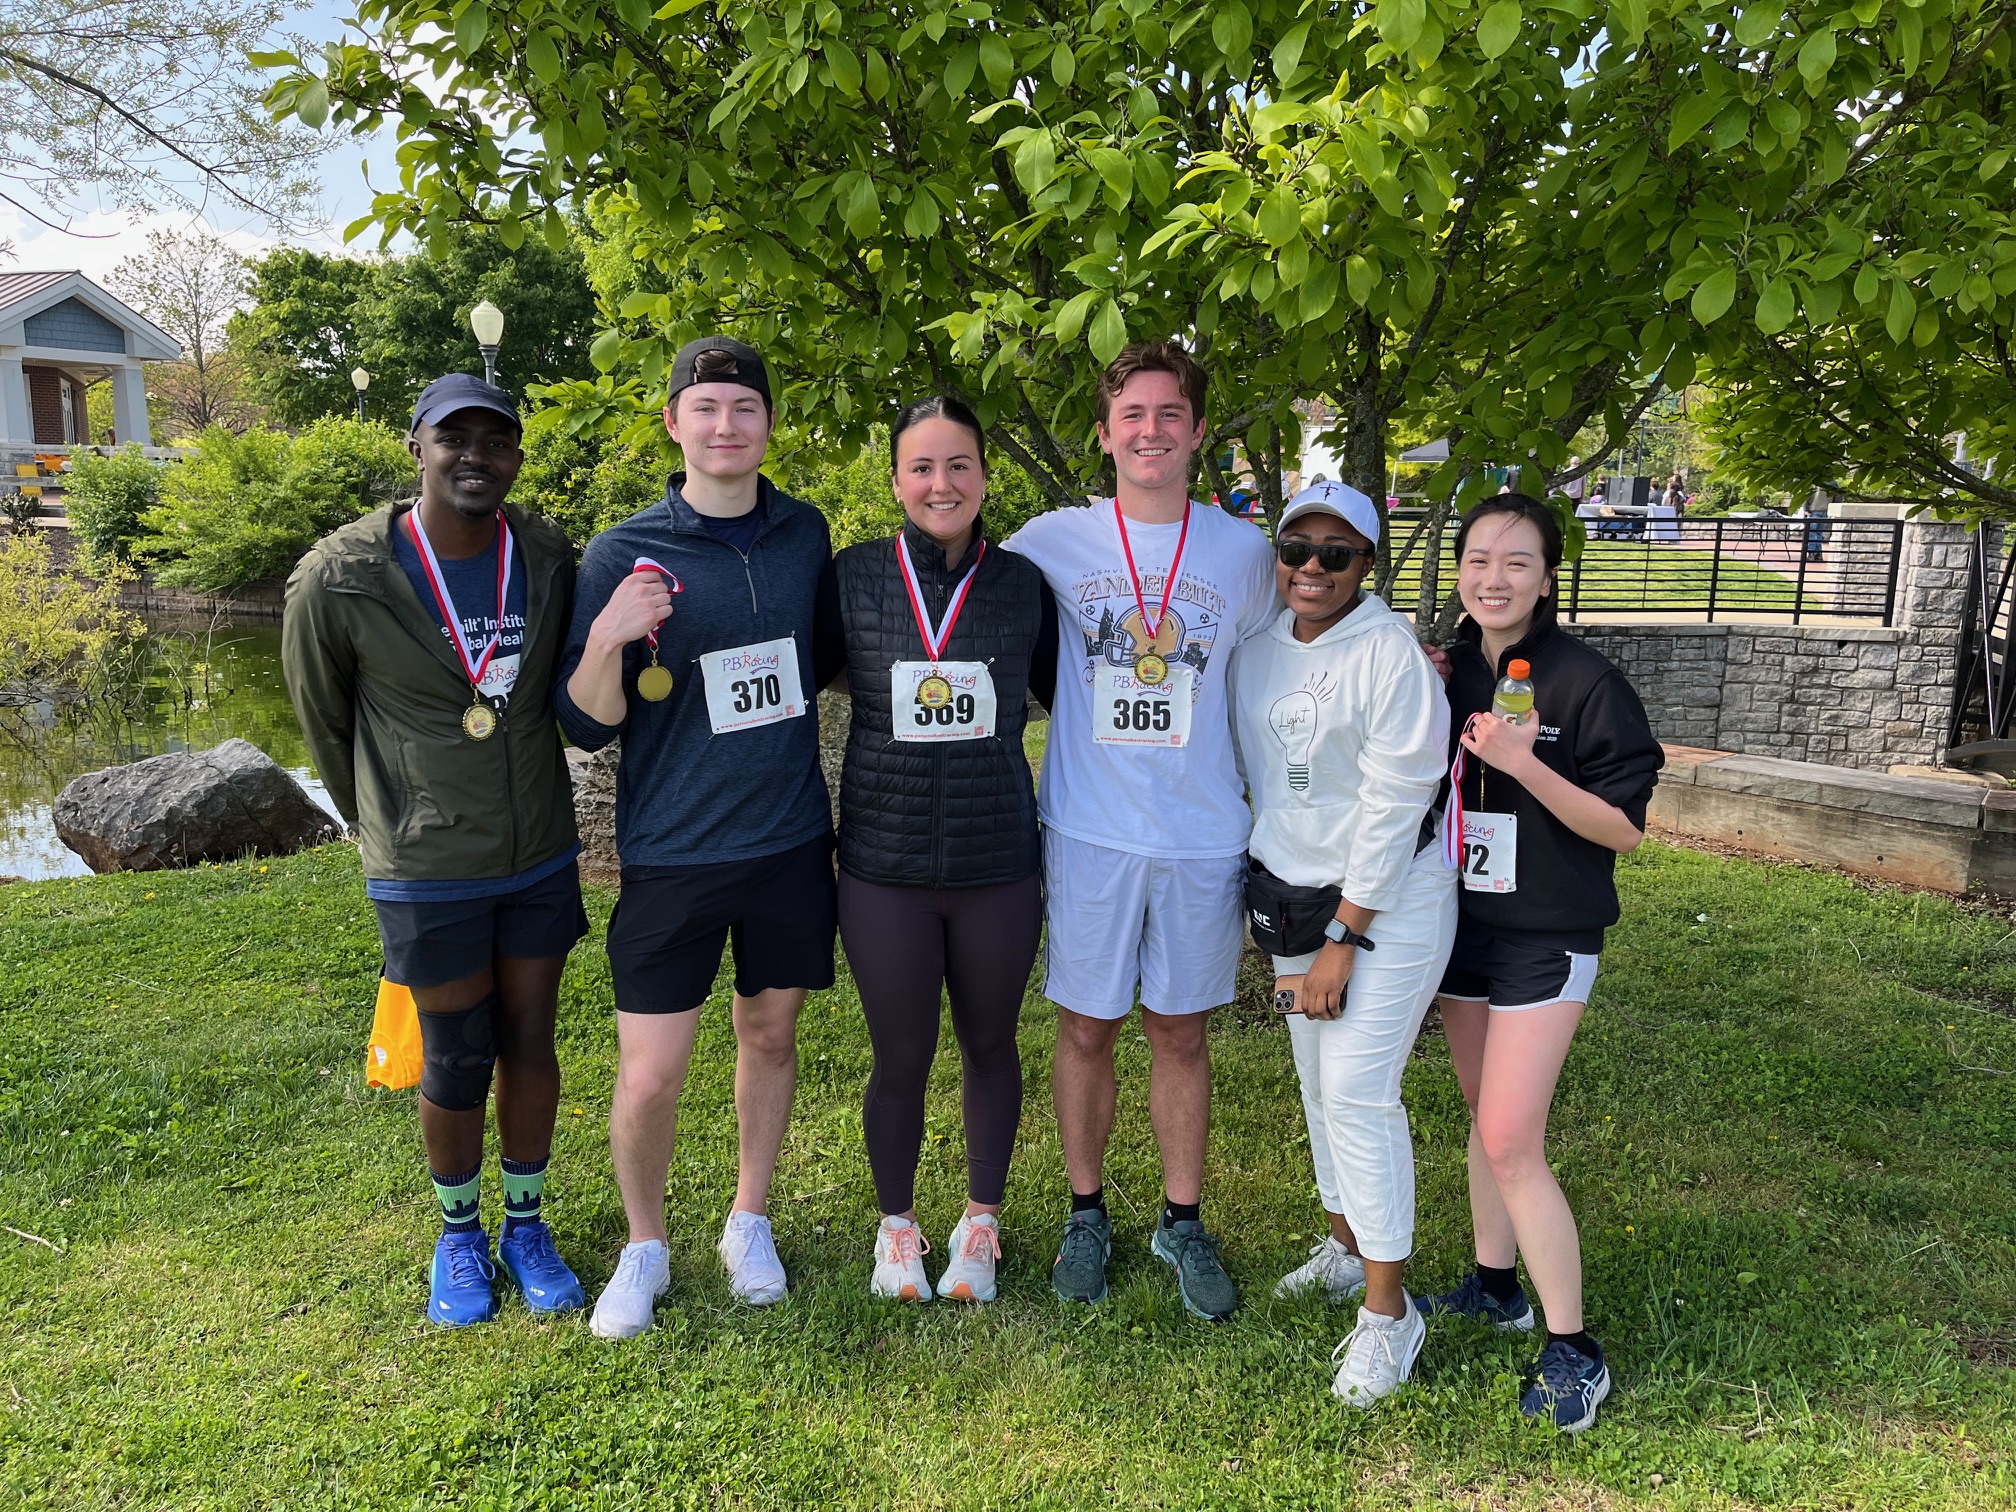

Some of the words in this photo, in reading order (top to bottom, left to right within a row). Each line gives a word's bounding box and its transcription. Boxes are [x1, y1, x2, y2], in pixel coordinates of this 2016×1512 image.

[1082, 566, 1149, 579] NASHVIE,
[1155, 566, 1218, 590] TEESSEE
[1072, 574, 1226, 618] VANDEBILT
[730, 673, 781, 714] 370
[914, 693, 975, 727] 369
[1113, 698, 1171, 732] 365
[1279, 707, 1311, 735] Light
[1539, 725, 1561, 735] POLY
